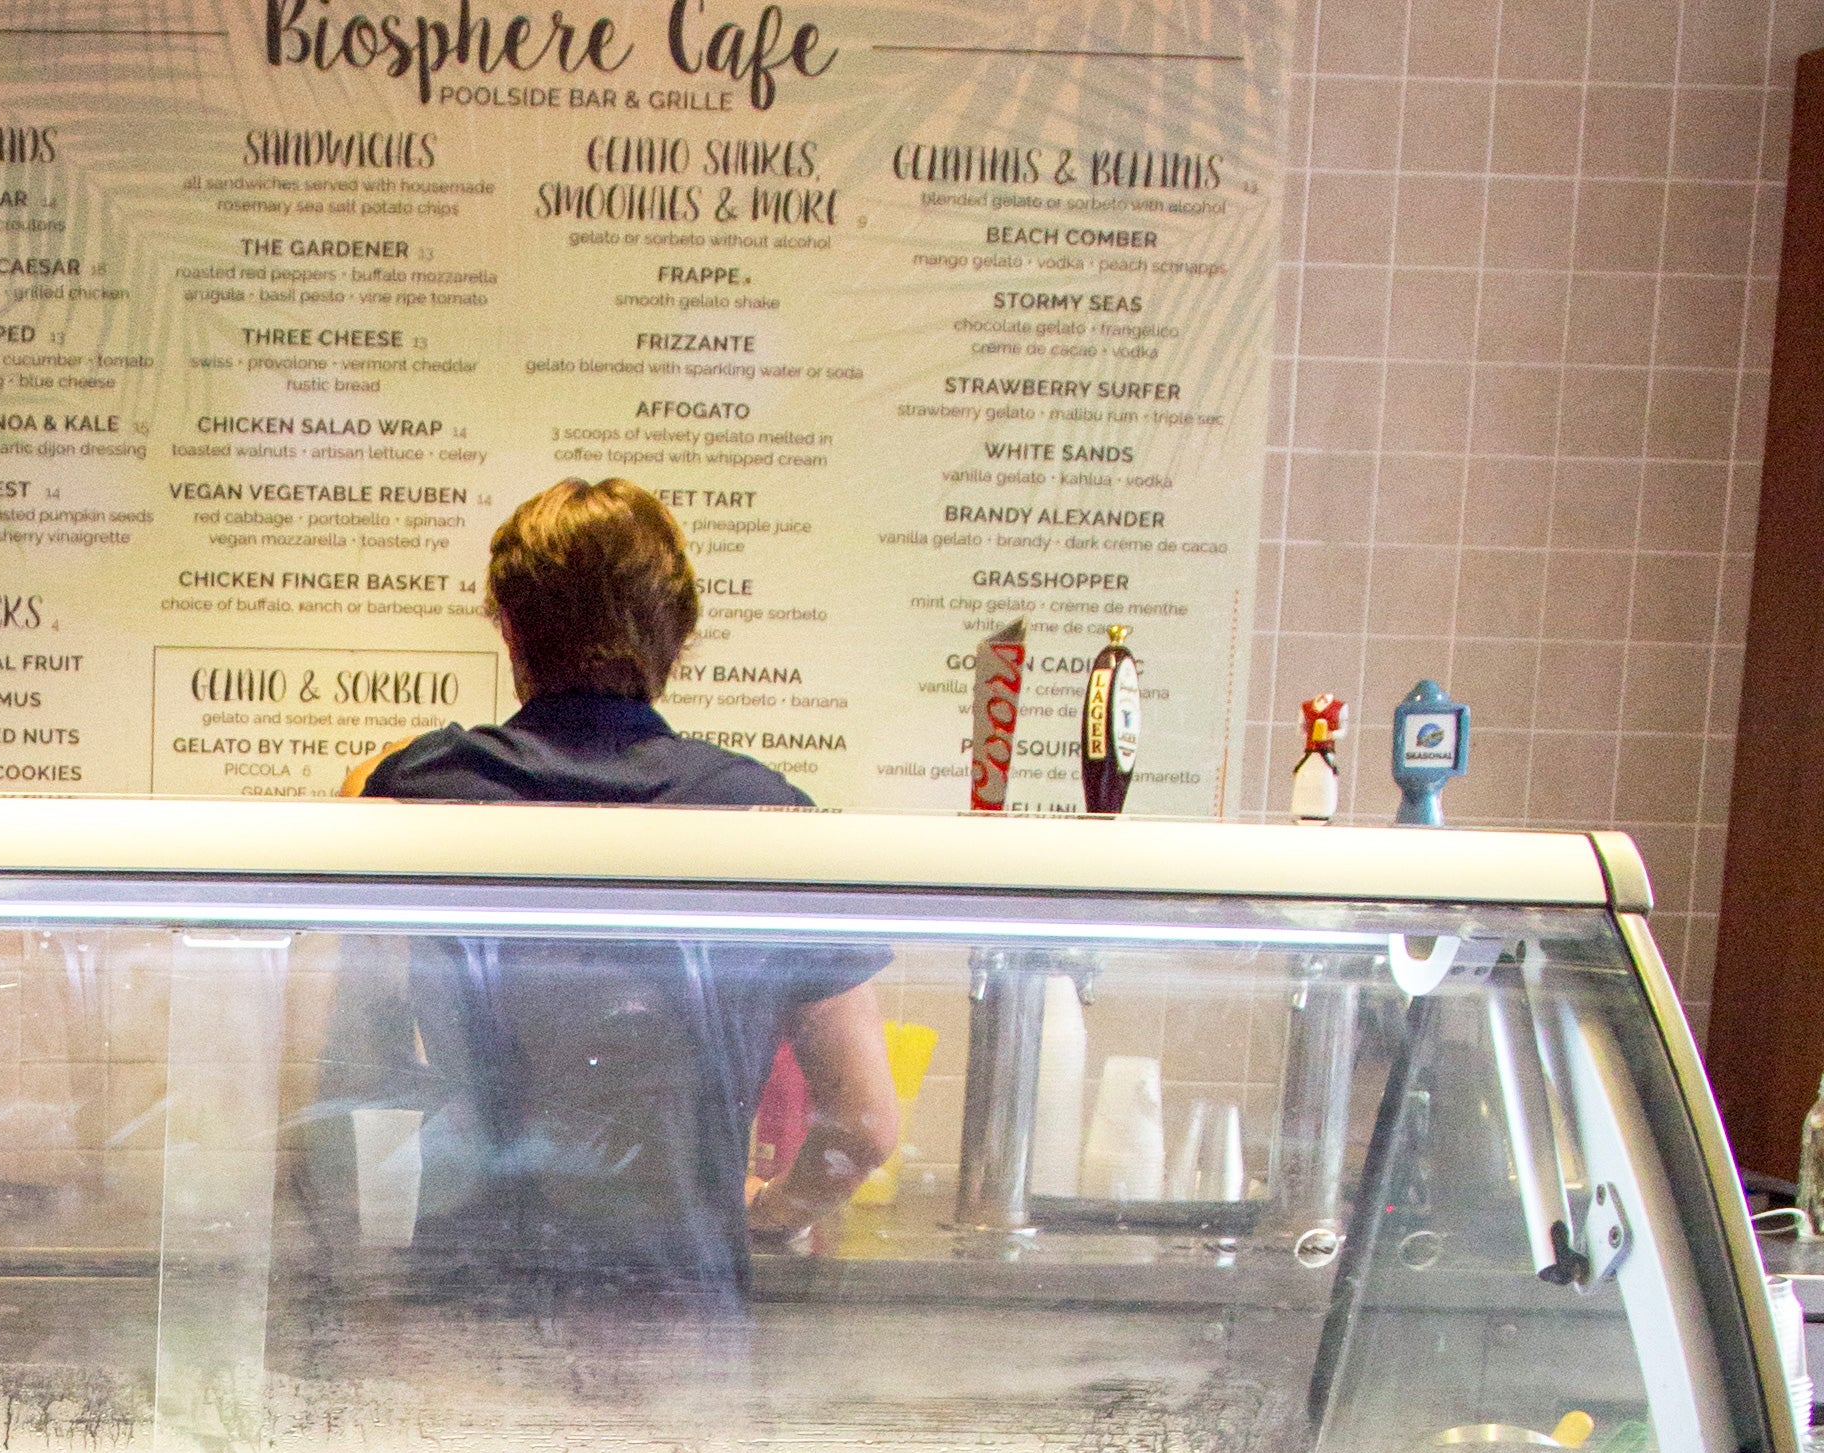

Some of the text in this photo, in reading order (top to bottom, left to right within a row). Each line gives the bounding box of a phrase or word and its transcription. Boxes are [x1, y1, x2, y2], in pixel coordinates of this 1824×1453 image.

[266, 0, 839, 111] Biosphere Cafe
[440, 86, 734, 112] POOLSIDE BAR & GRILLE
[244, 128, 437, 169] SANDWICHES
[588, 135, 690, 174] GELATO
[1054, 150, 1076, 186] &
[535, 181, 838, 226] SMOOTHIES & MORE
[986, 227, 1157, 248] BEACH COMBER
[241, 239, 409, 258] THE GARDENER
[659, 266, 740, 285] FRAPPE
[615, 293, 780, 310] smooth gelato shake
[993, 292, 1141, 313] STORMY SEAS
[242, 328, 403, 347] THREE CHEESE
[637, 333, 755, 352] FRIZZANTE
[527, 358, 863, 380] gelato blended with sparkling water or soda
[945, 376, 1180, 401] STRAWBERRY SURFER
[636, 400, 750, 419] AFFOGATO
[45, 415, 56, 431] &
[65, 415, 120, 432] KALE
[197, 416, 442, 437] CHICKEN SALAD WRAP
[555, 447, 827, 467] coffee topped with whipped cream
[985, 442, 1133, 463] WHITE SANDS
[169, 482, 467, 503] VEGAN VEGETABLE REUBEN
[654, 490, 756, 508] EET TART
[195, 510, 465, 529] red cabbage portobello spinach
[693, 518, 812, 535] pineapple juice
[944, 505, 1165, 529] BRANDY ALEXANDER
[210, 533, 450, 550] vegan mozzarella toasted rye
[708, 540, 745, 554] juice
[879, 531, 1228, 554] vanilla gelato brandy dark de cacao
[179, 571, 449, 591] CHICKEN FINGER BASKET
[973, 570, 1129, 590] GRASSHOPPER
[708, 608, 828, 622] orange sorbeto
[911, 595, 1187, 617] mint chip gelato de menthe
[23, 655, 84, 671] FRUIT
[713, 666, 802, 685] BANANA
[192, 667, 459, 705] GELATO & SORBETO
[919, 679, 967, 694] vanilla
[717, 695, 776, 707] sorbeto
[792, 695, 848, 708] banana
[202, 712, 446, 730] gelato and sorbet are made daily
[1090, 673, 1104, 754] LAGER
[23, 729, 79, 744] NUTS
[762, 734, 846, 751] BANANA
[173, 738, 376, 756] GELATO BY THE CUP
[226, 763, 290, 777] PICCOLA
[877, 762, 926, 778] vanilla
[1047, 767, 1066, 779] de
[242, 786, 306, 797] GRANDE
